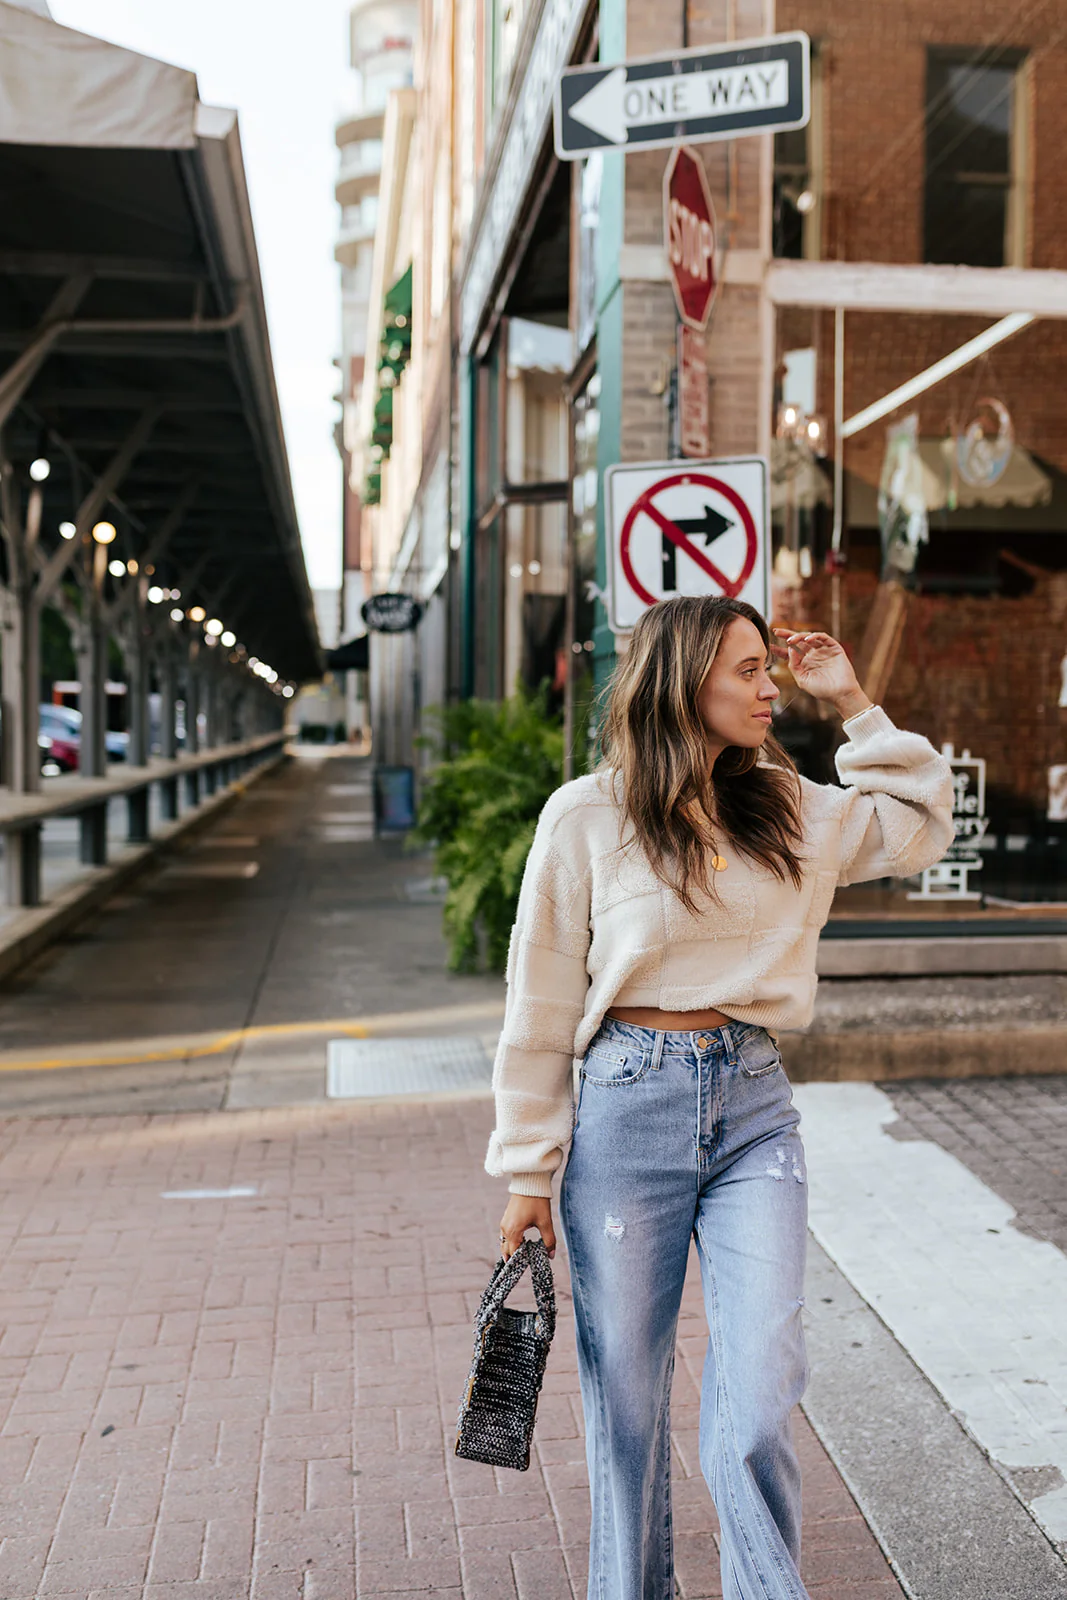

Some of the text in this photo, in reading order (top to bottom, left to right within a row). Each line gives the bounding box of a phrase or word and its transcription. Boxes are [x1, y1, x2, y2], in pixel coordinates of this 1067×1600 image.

[624, 68, 780, 119] ONE WAY
[669, 197, 714, 282] STOP
